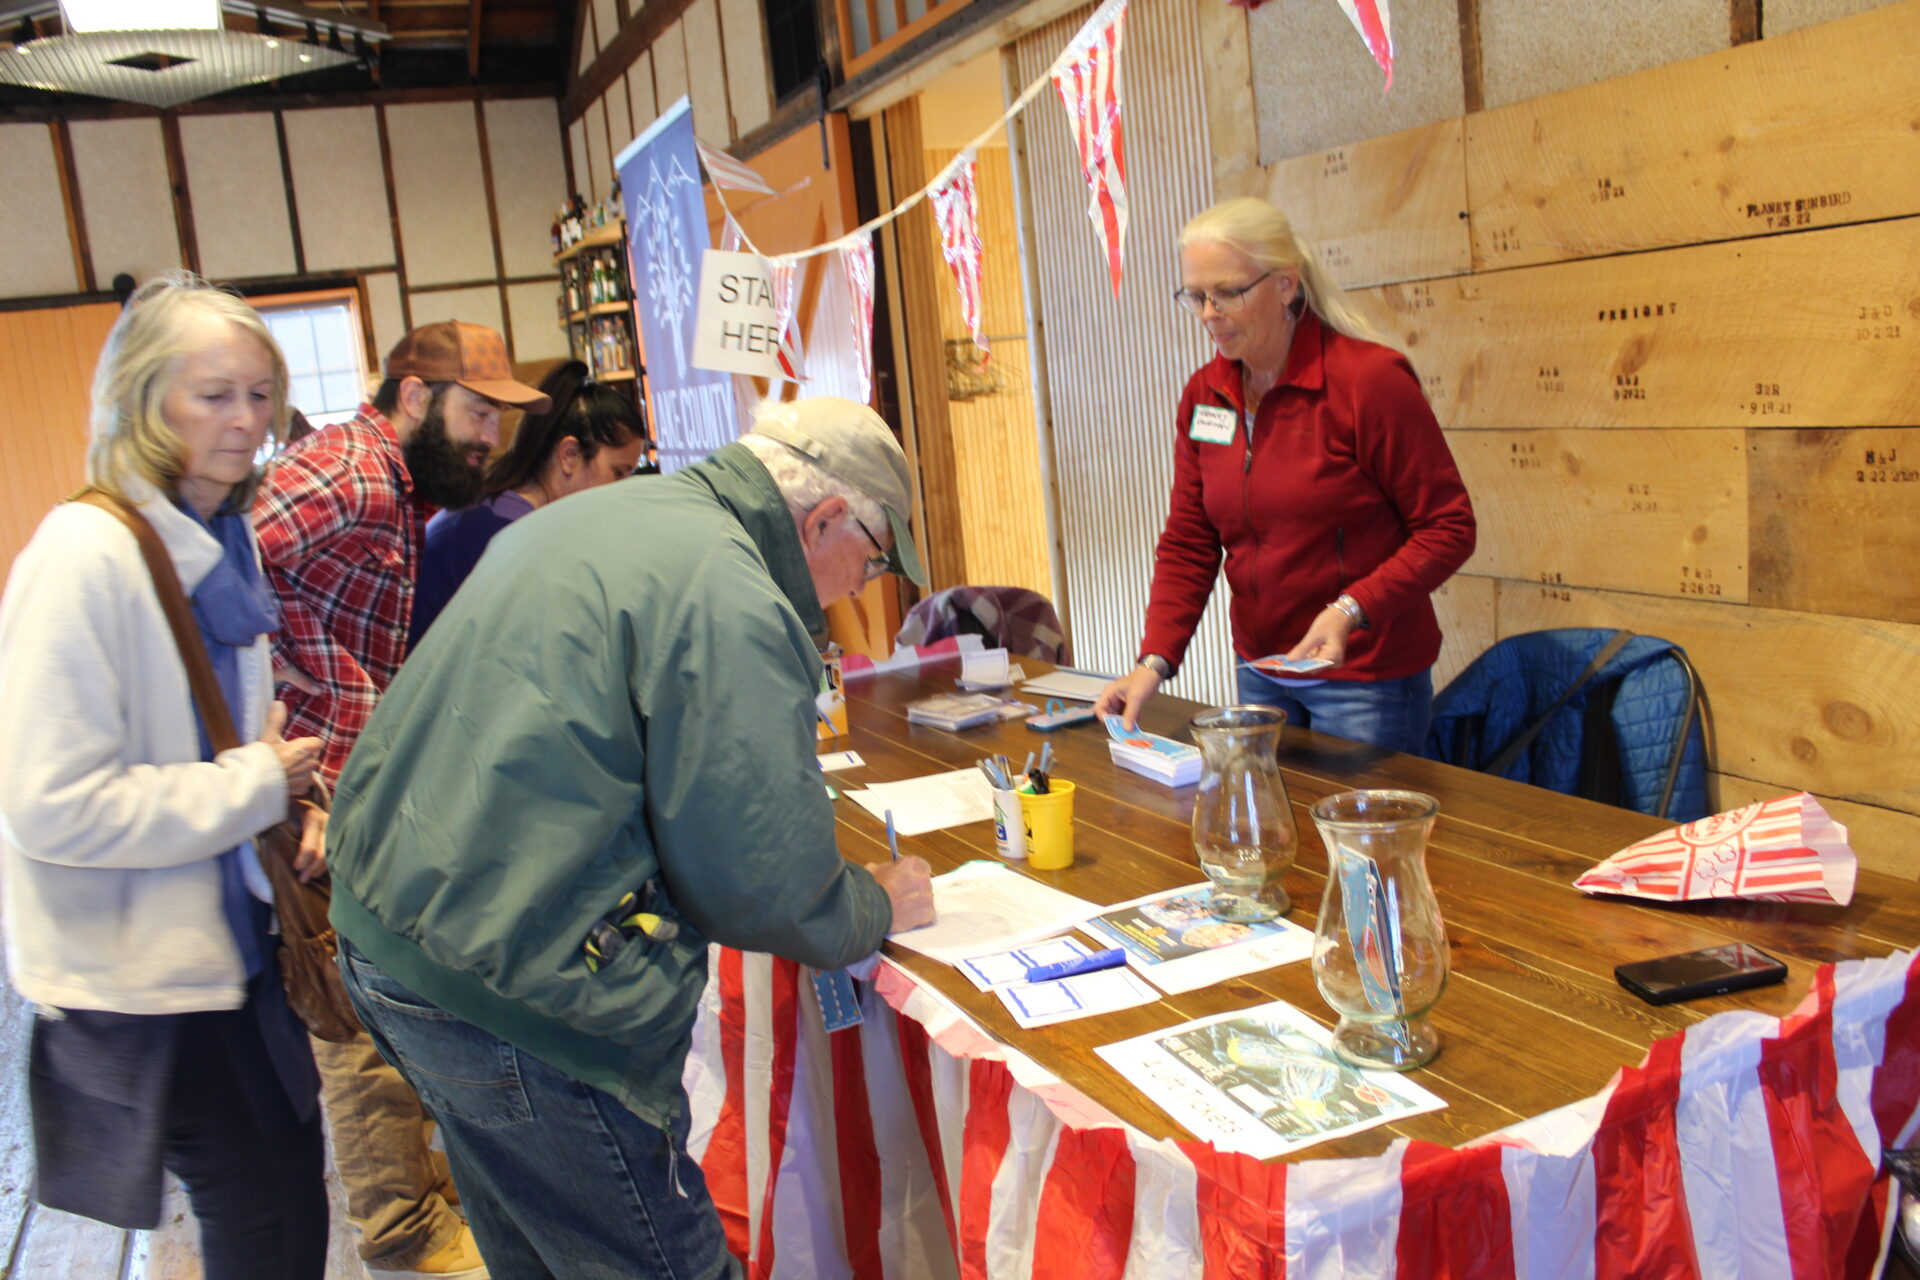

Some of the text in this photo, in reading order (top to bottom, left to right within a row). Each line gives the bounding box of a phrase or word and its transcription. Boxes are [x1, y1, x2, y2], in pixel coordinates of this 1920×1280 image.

[718, 273, 777, 309] STA
[720, 320, 780, 354] HER
[651, 381, 737, 450] LAKE COUNTY
